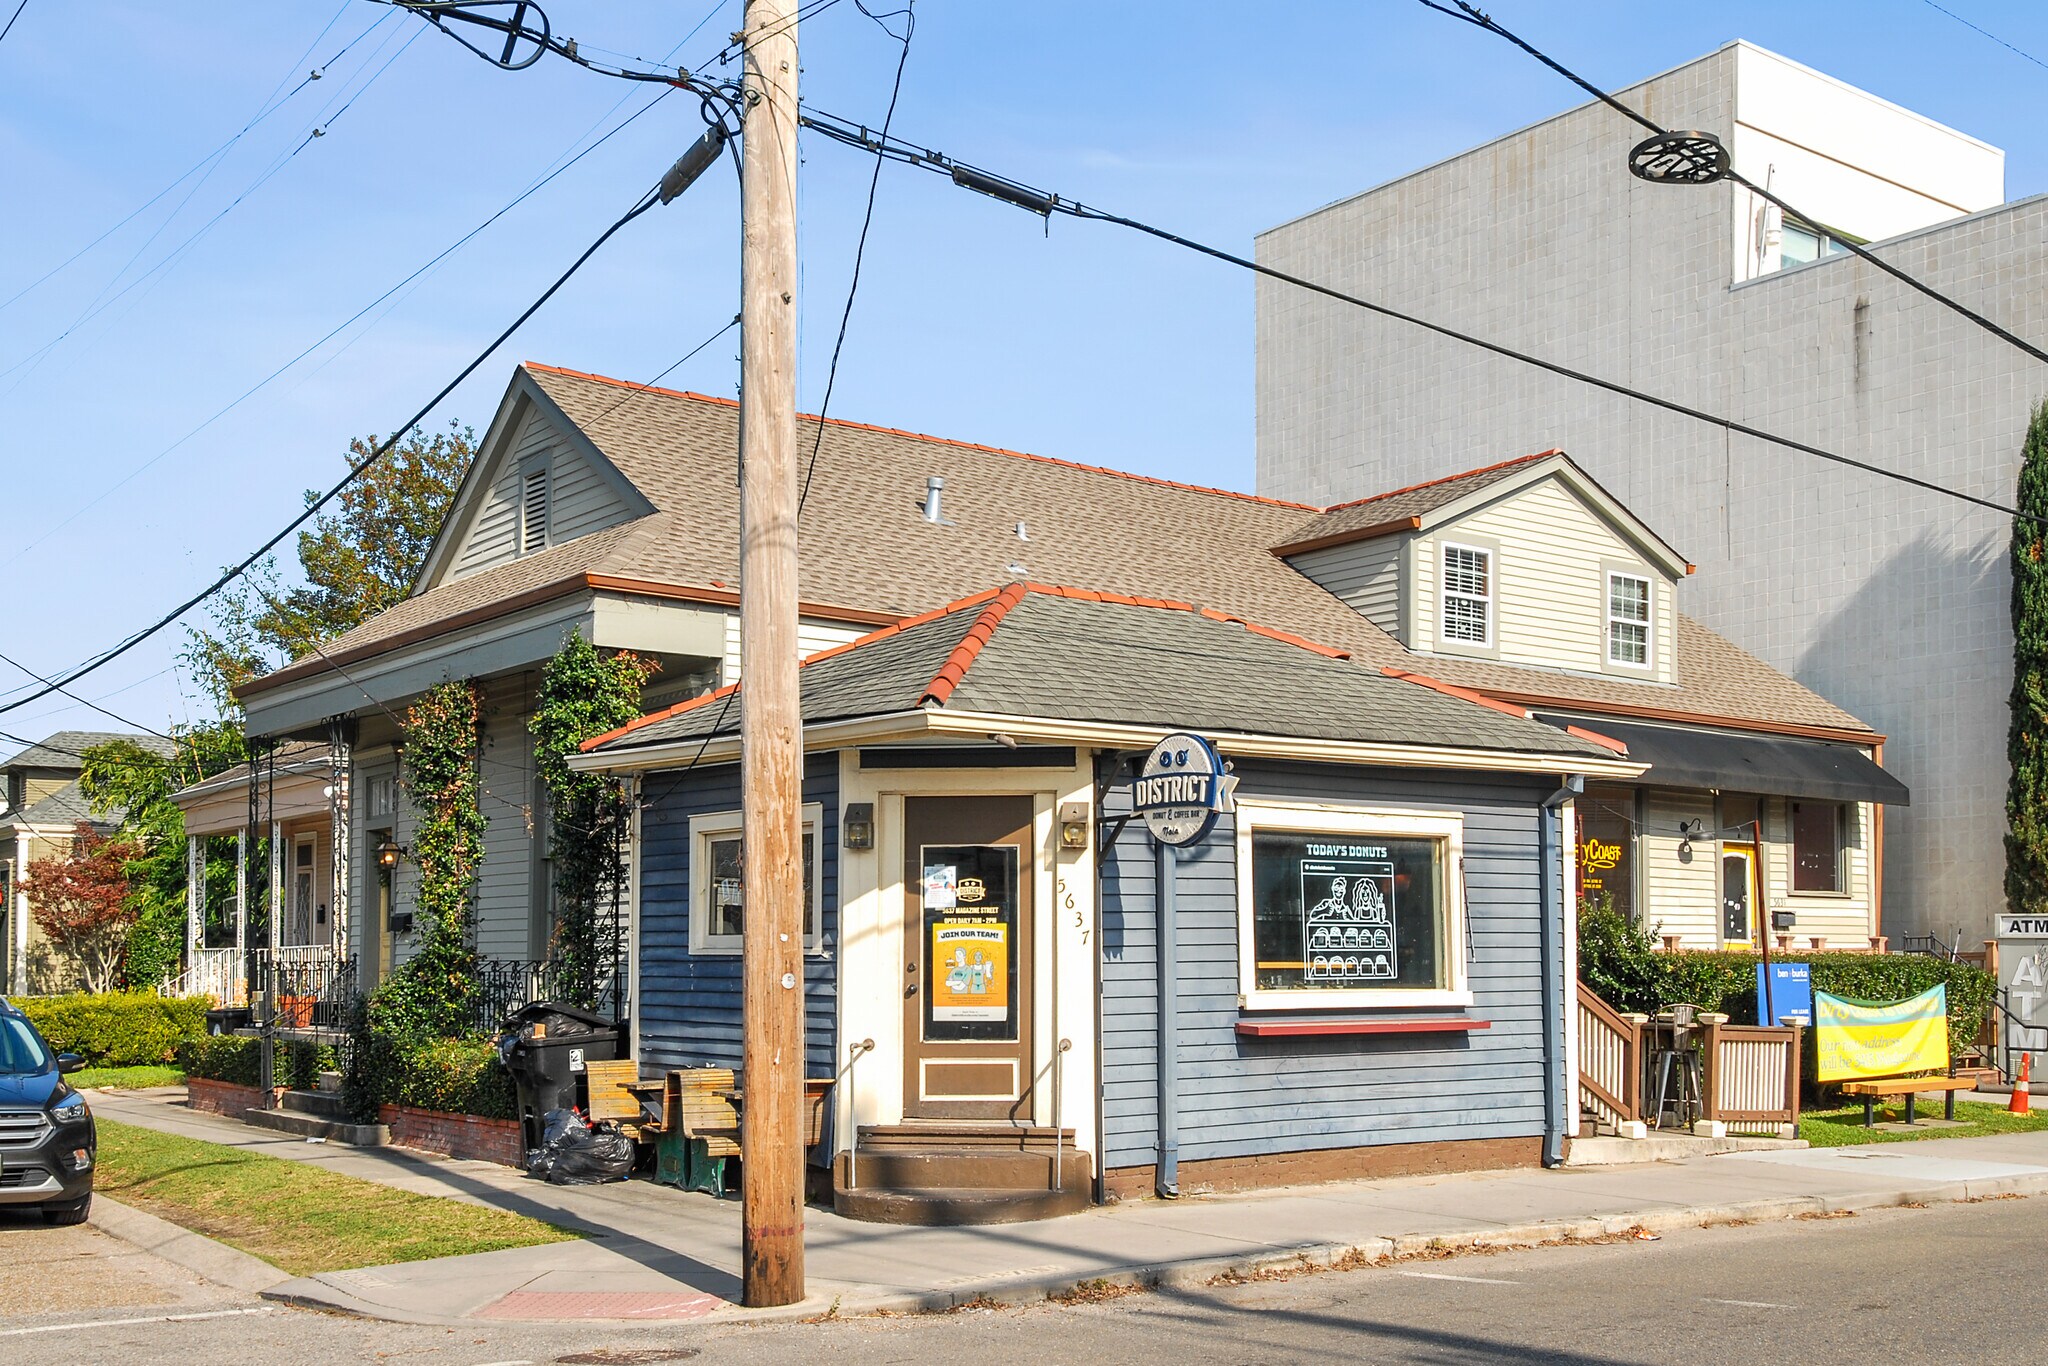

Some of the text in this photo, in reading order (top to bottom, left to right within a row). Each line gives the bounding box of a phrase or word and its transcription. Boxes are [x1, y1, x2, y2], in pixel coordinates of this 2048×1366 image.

[1136, 775, 1209, 807] DISTRICT
[1152, 811, 1166, 820] DONUT
[1174, 810, 1189, 818] COFFEE
[1306, 844, 1388, 858] TODAY'S DONUTS
[955, 906, 980, 914] MAGAZINE
[981, 906, 999, 914] STREET
[1058, 879, 1090, 945] 5637
[2009, 920, 2048, 933] ATM
[941, 931, 959, 939] JOIN
[976, 930, 999, 939] TEAM!
[1819, 1001, 1850, 1020] Dirty
[2011, 956, 2044, 1056] ATM
[1820, 1038, 1841, 1052] Our
[1861, 1035, 1900, 1049] address
[1820, 1055, 1837, 1069] will
[1839, 1054, 1852, 1068] be
